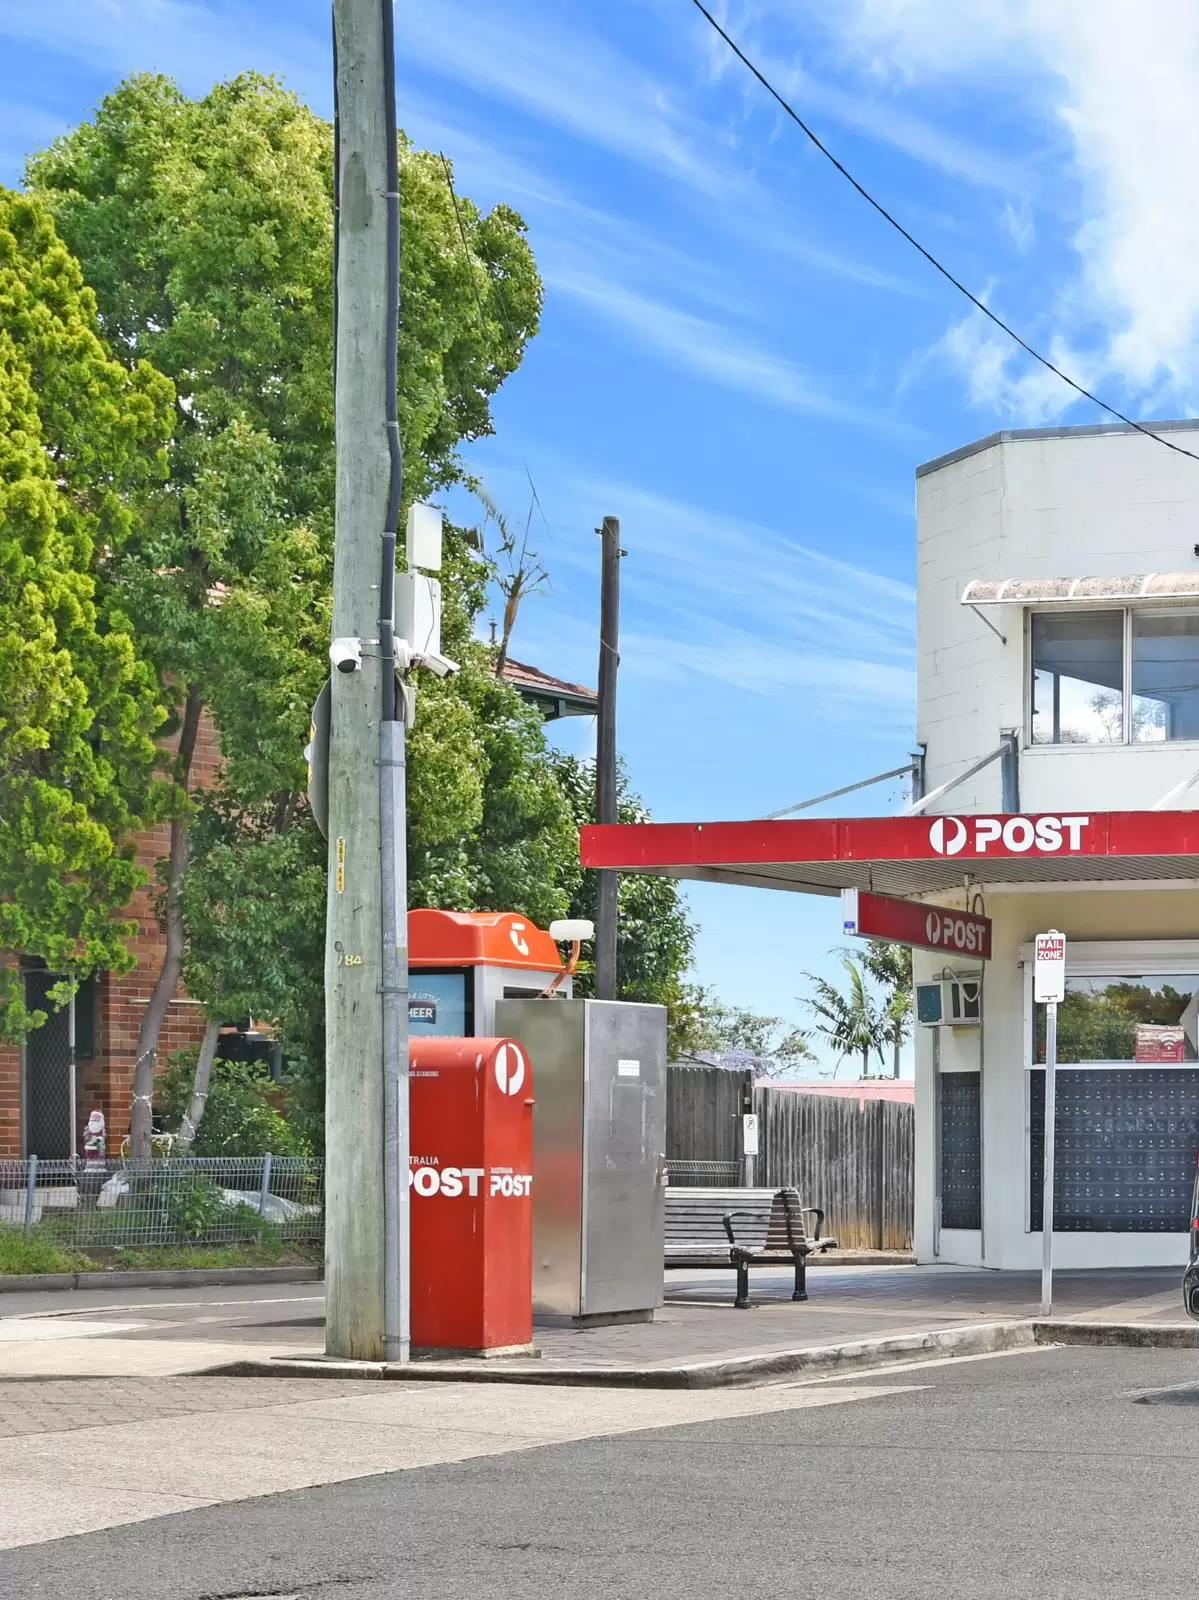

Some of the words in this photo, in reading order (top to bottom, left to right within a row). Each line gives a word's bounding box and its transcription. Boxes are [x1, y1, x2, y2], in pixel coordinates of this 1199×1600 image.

[975, 816, 1089, 852] POST
[943, 917, 986, 952] POST
[1038, 940, 1063, 949] MAIL
[1038, 950, 1062, 960] ZONE
[490, 1175, 533, 1197] POST
